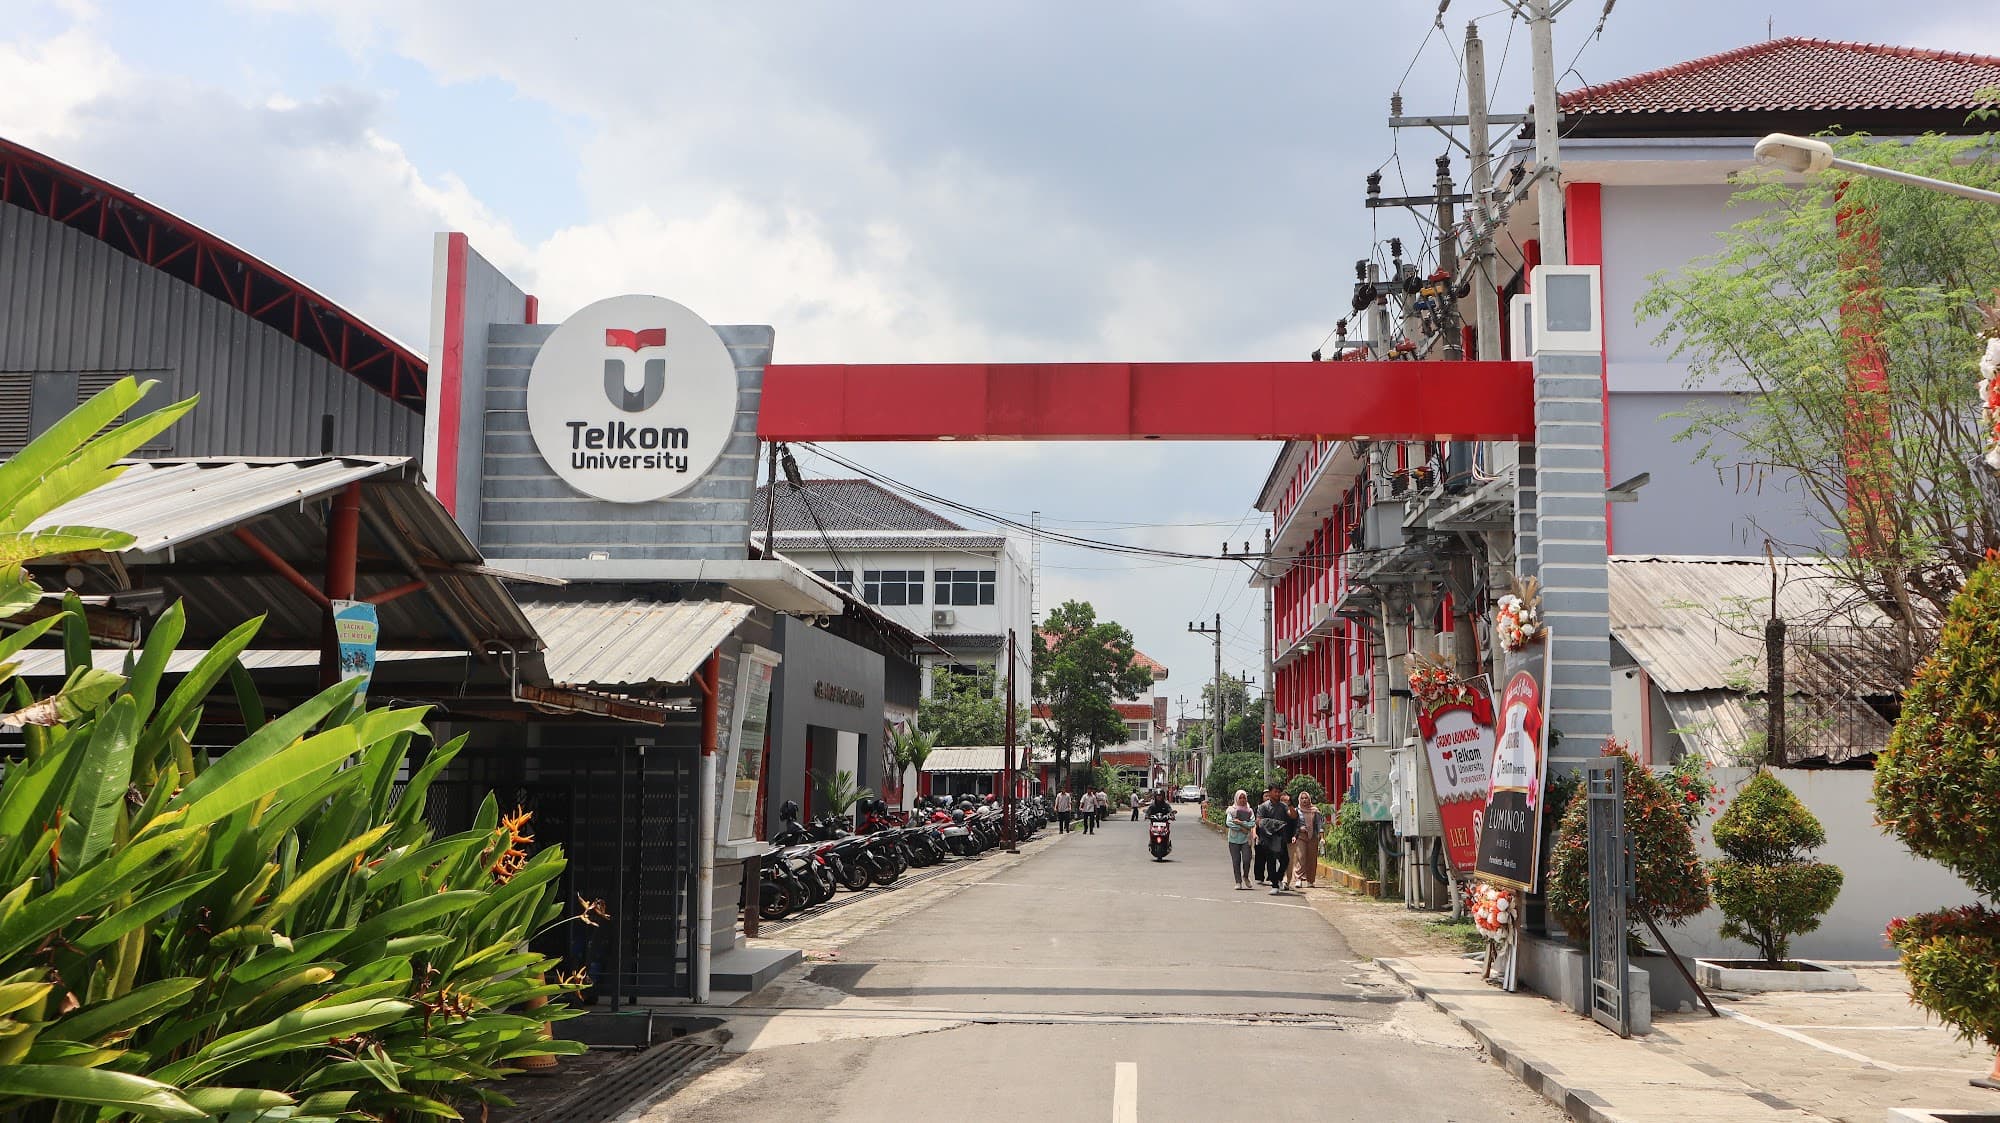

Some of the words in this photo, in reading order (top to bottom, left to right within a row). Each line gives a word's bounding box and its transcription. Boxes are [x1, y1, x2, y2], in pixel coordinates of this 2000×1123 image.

[566, 421, 689, 449] Telkom
[572, 452, 688, 473] University
[1435, 734, 1452, 749] GRAND
[1452, 727, 1480, 745] LAUNCHING
[1453, 747, 1482, 763] Telkom
[1457, 763, 1485, 774] University
[1488, 808, 1525, 833] LUMINOR
